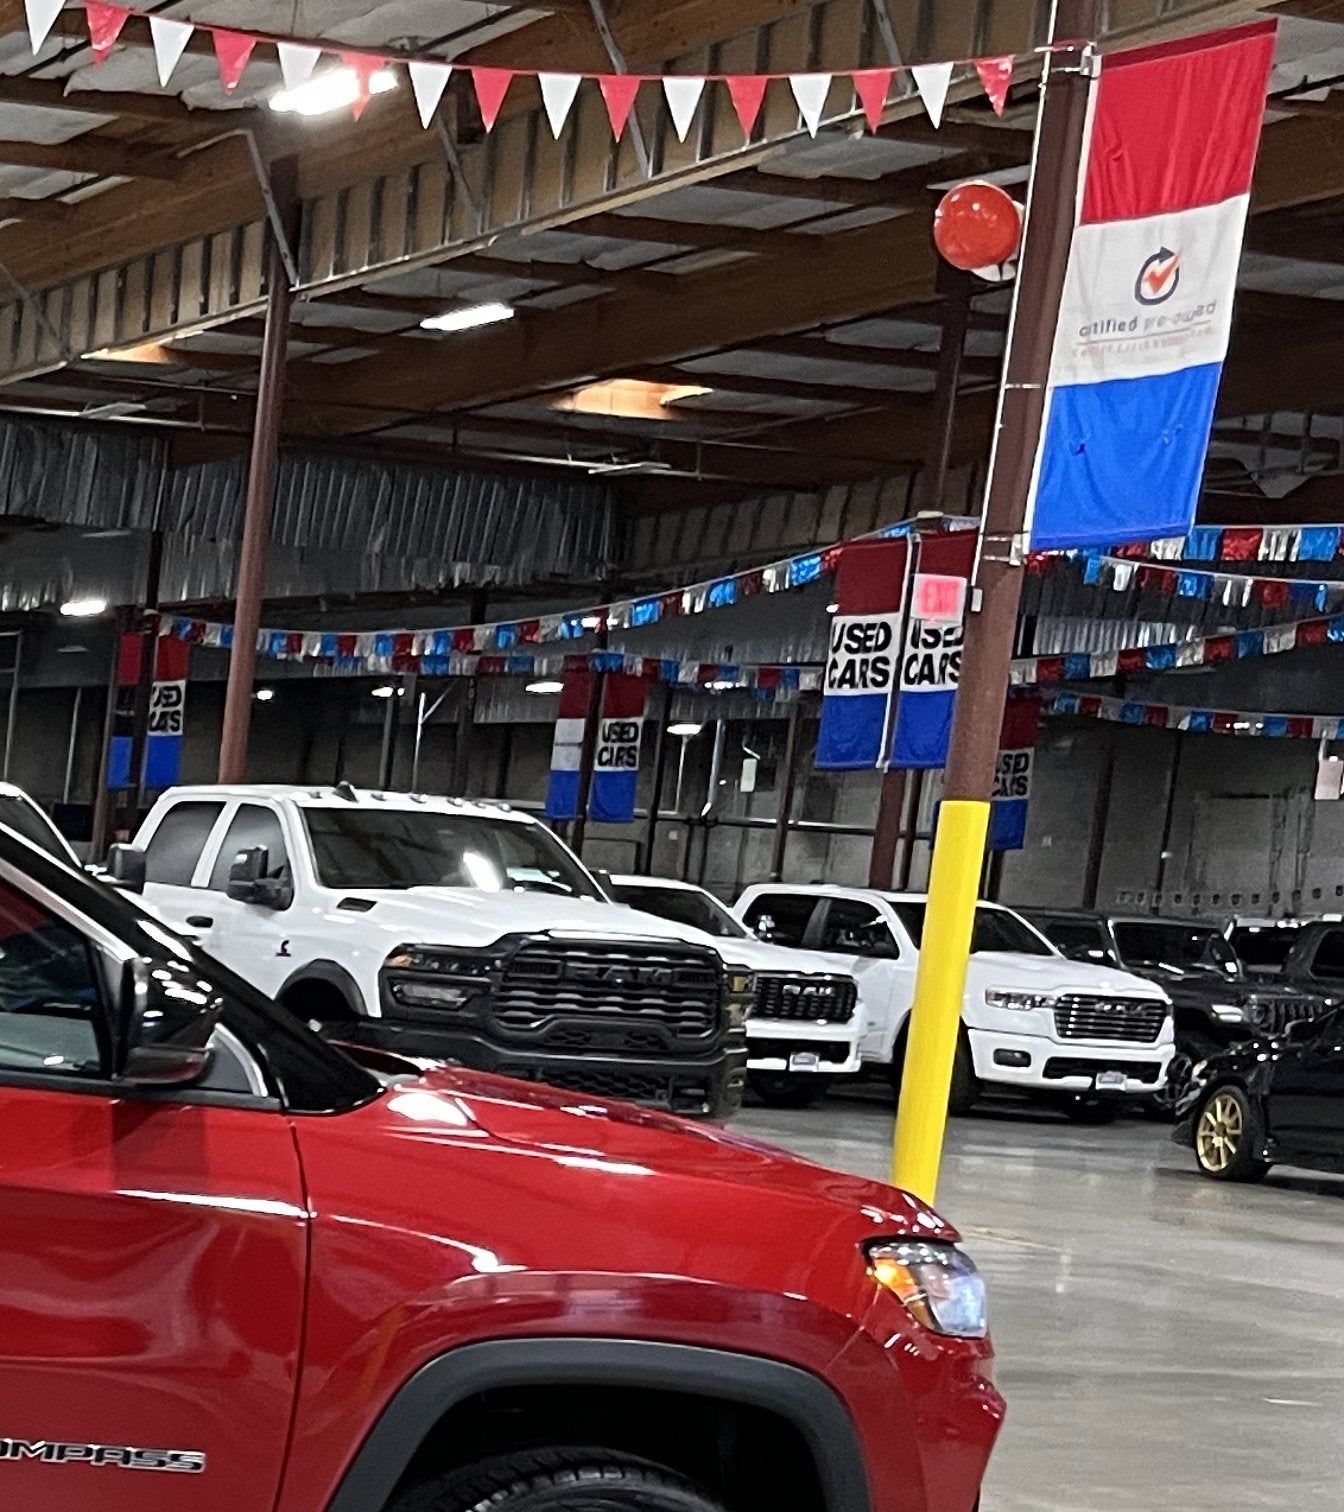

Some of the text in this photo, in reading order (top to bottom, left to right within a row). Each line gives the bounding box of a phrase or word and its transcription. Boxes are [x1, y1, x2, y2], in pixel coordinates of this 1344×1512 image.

[828, 656, 890, 688] CARS
[904, 651, 961, 686] CARS
[602, 721, 639, 743] USED
[566, 961, 673, 985] RAM
[782, 984, 833, 997] RAM
